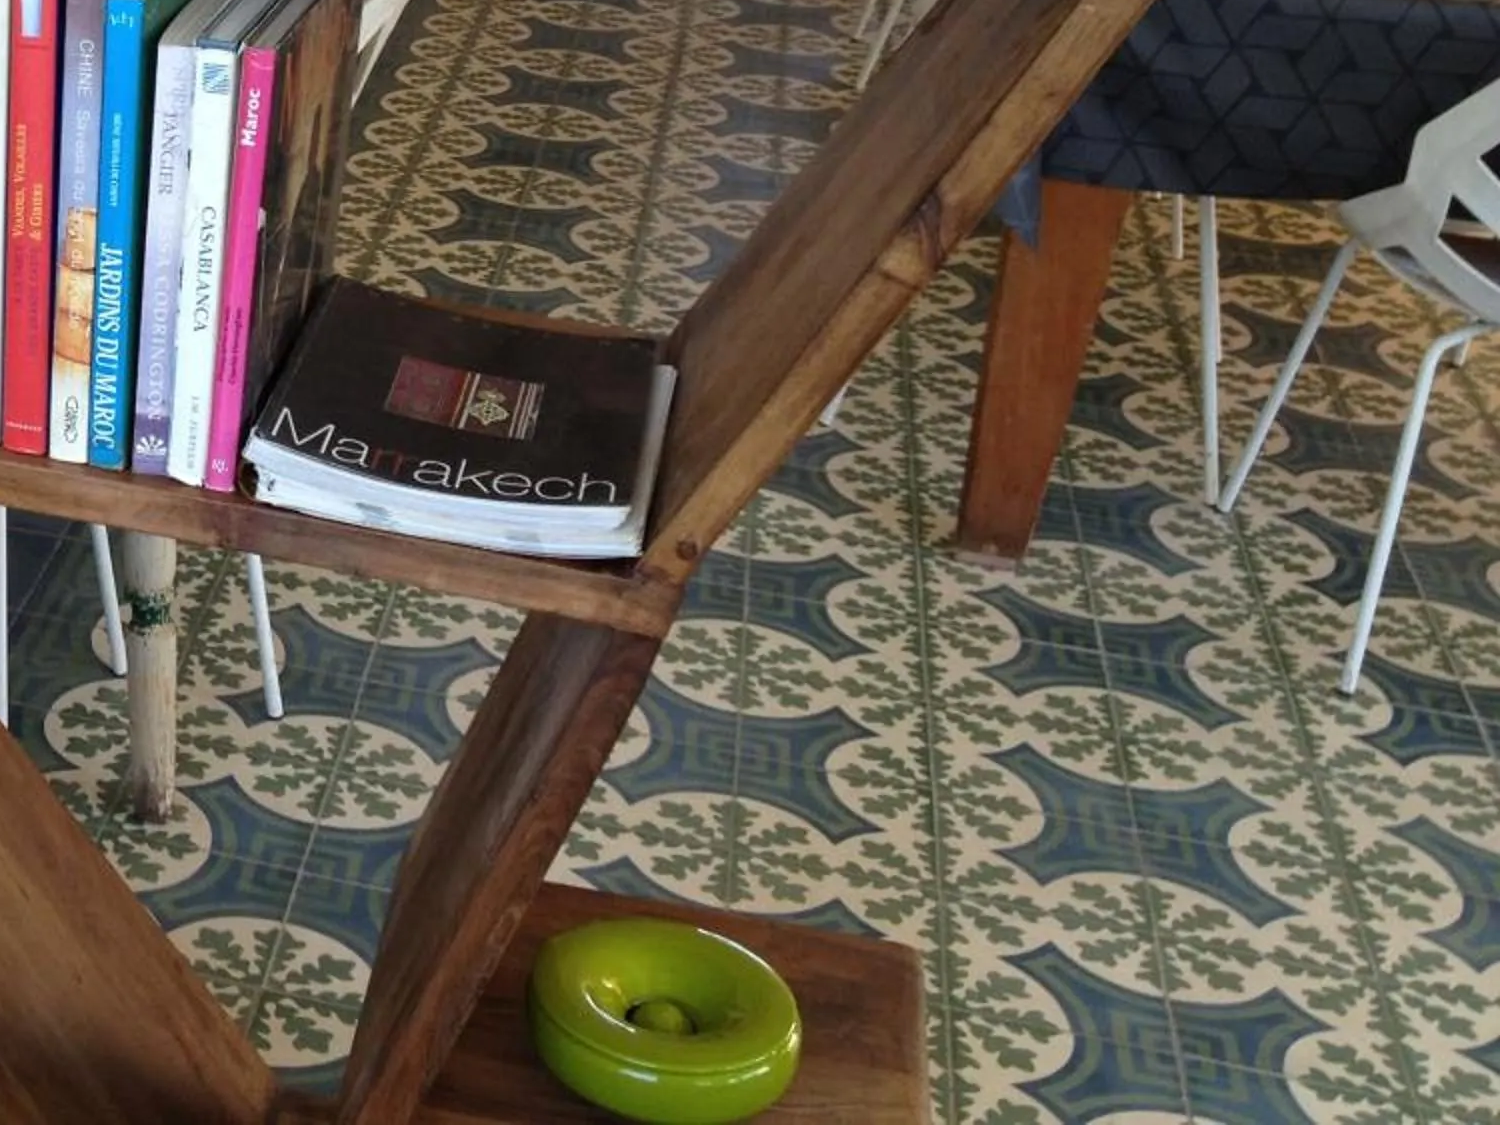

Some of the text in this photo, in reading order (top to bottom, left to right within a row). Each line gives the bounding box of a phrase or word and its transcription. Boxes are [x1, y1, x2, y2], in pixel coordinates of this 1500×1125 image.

[77, 38, 95, 98] CHINE
[158, 111, 180, 195] TANGIER
[240, 87, 261, 148] Maroc
[193, 206, 217, 332] CASABLANCA
[92, 242, 124, 450] JARDINS DU MAROC
[147, 276, 169, 420] CODRINGTON
[271, 406, 618, 504] Marrakech
